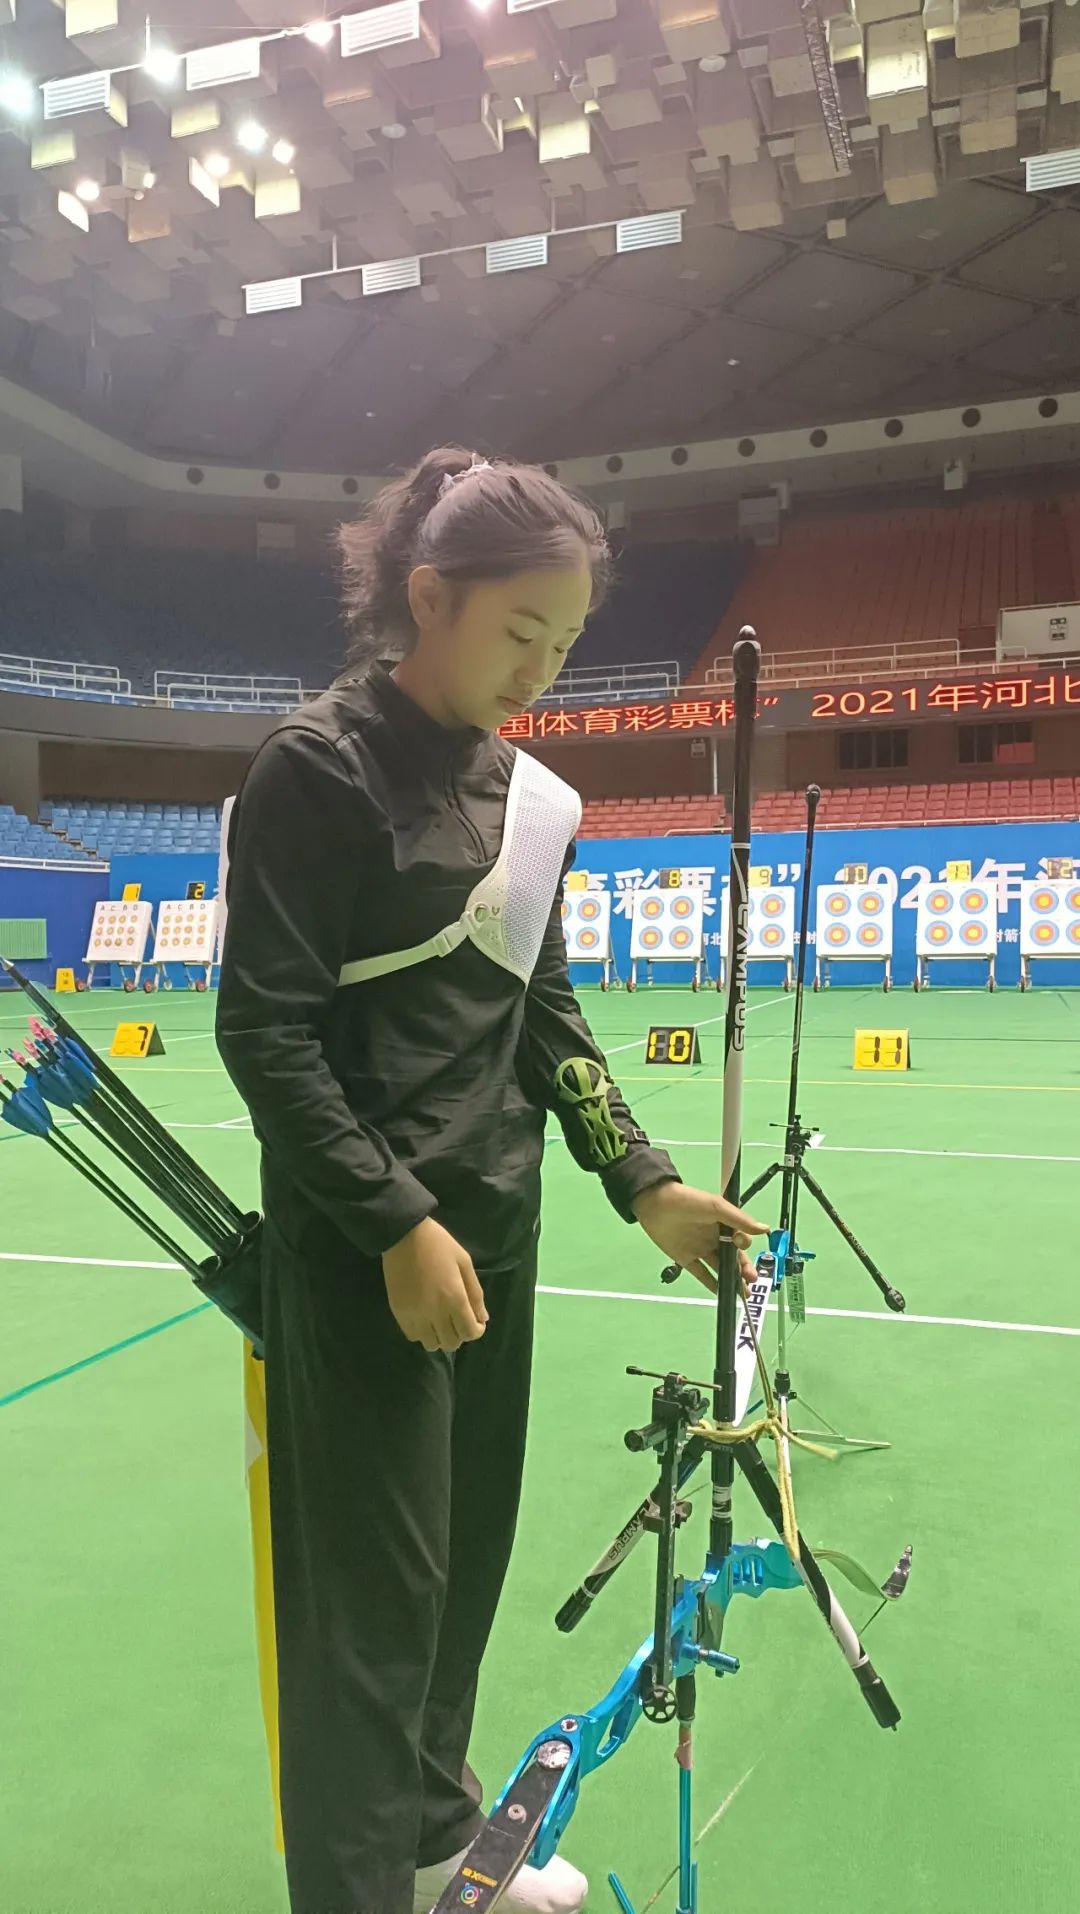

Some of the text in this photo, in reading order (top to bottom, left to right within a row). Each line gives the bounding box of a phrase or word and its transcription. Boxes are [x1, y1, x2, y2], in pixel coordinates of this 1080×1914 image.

[811, 675, 1080, 717] 2021年河北
[668, 869, 680, 887] 8
[760, 868, 770, 885] 9
[845, 866, 866, 883] 10
[1047, 859, 1072, 879] 12
[194, 883, 205, 899] 2
[733, 902, 749, 1051] CAMPUS
[137, 1025, 148, 1051] 7
[648, 1030, 690, 1063] 10
[873, 1036, 902, 1064] 11
[737, 1284, 768, 1352] SAMICK
